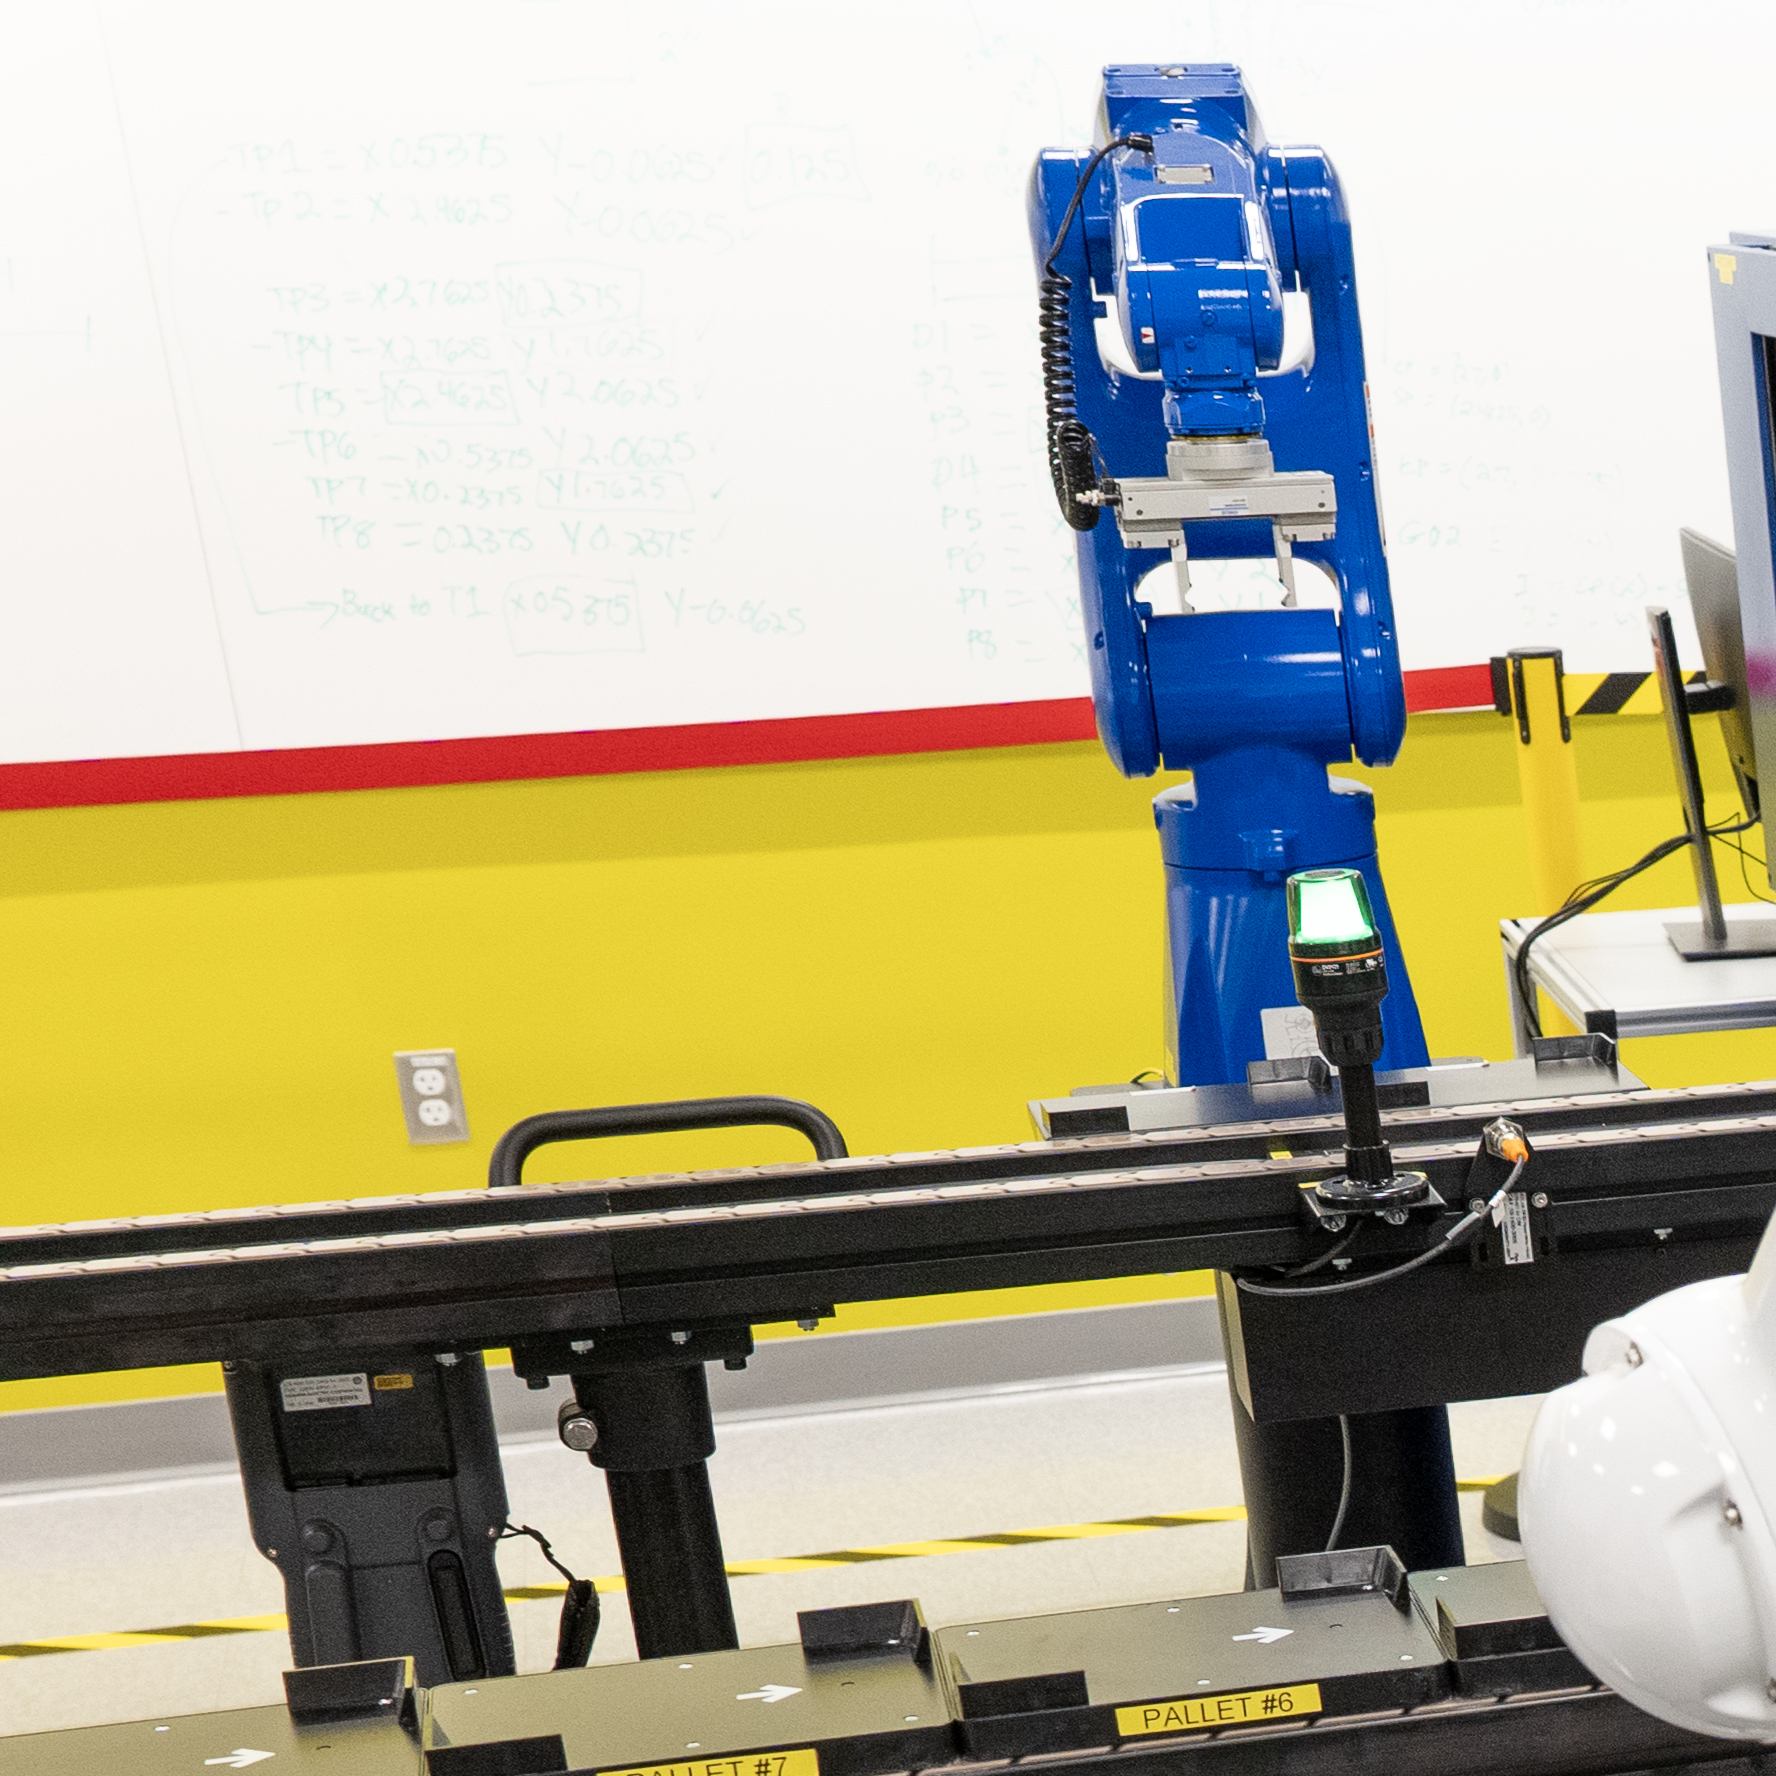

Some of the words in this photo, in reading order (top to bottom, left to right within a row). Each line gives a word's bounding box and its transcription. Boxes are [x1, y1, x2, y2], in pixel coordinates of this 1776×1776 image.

[342, 587, 397, 623] Back
[409, 593, 432, 618] to
[1142, 1697, 1252, 1730] PALLET
[1262, 1692, 1294, 1714] #6
